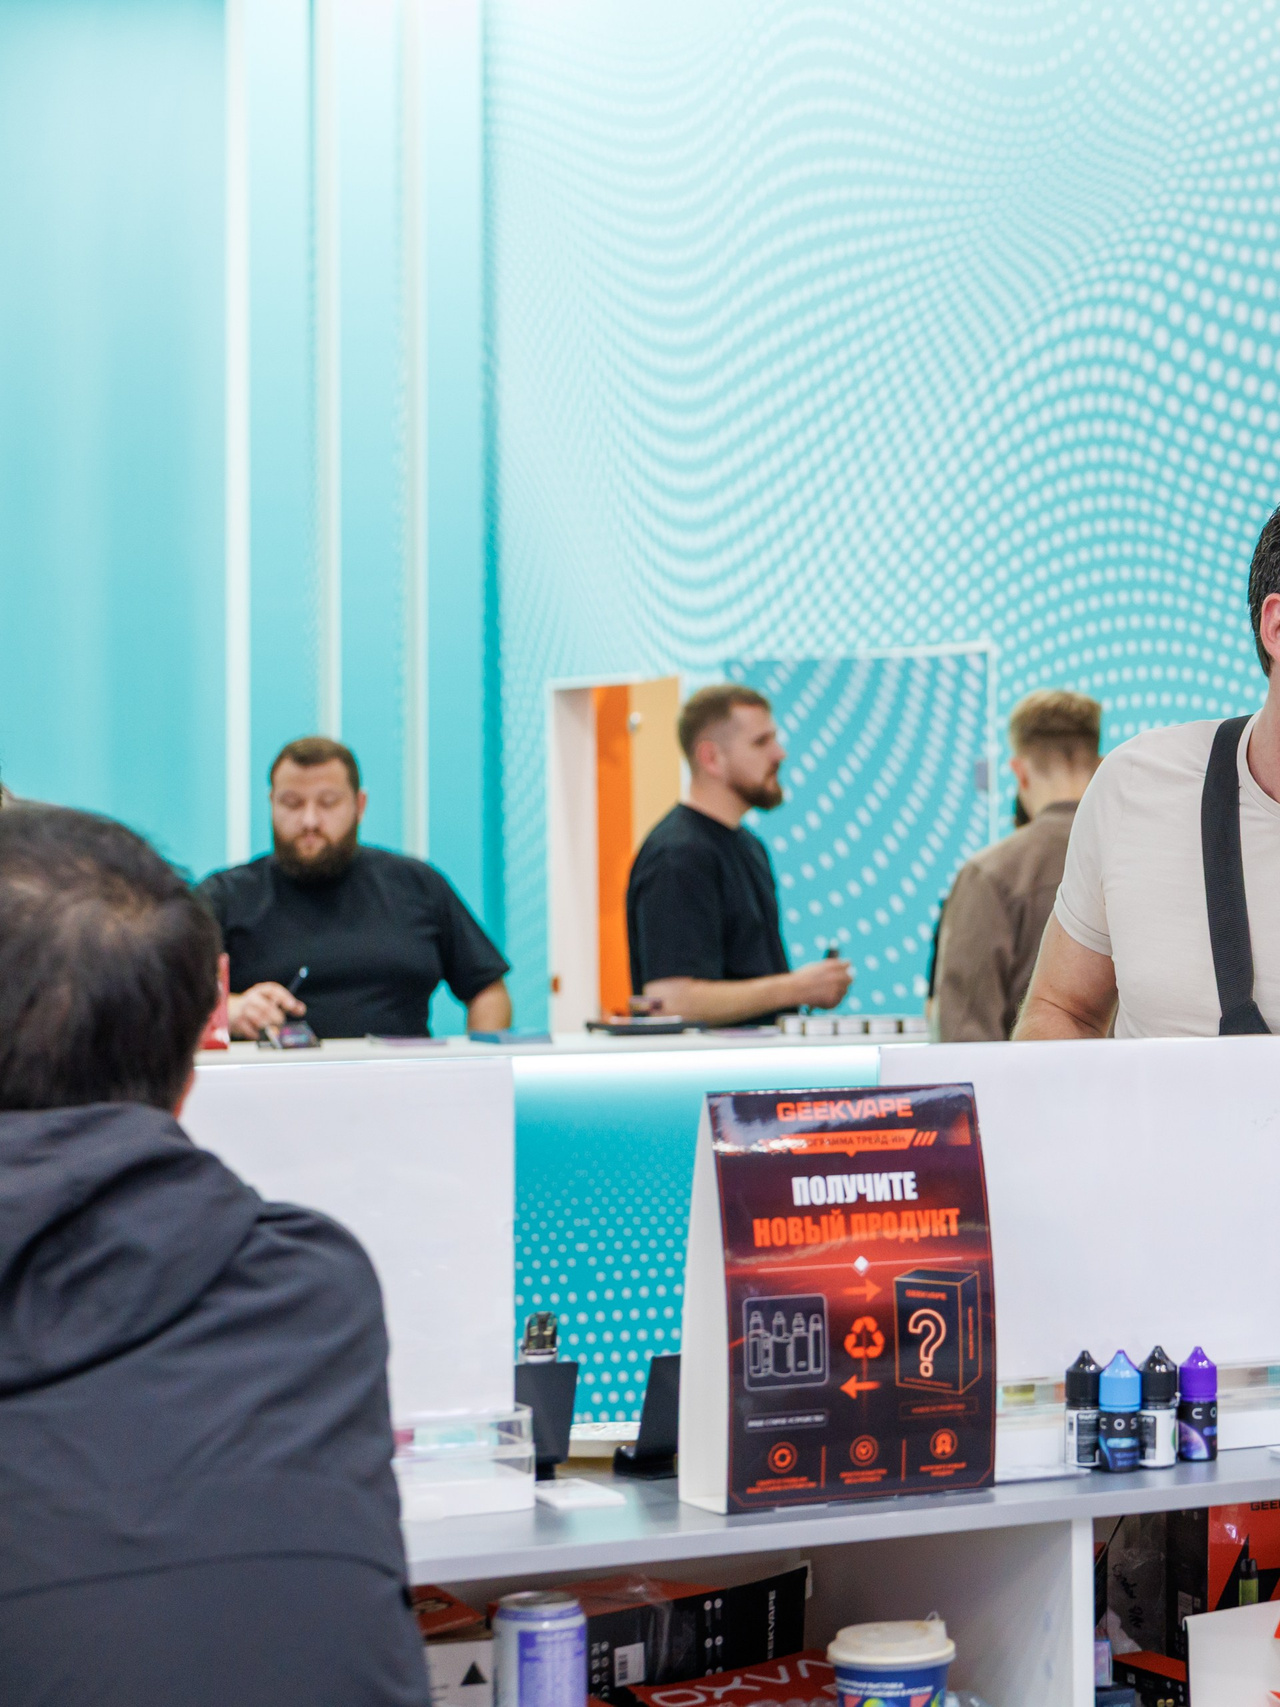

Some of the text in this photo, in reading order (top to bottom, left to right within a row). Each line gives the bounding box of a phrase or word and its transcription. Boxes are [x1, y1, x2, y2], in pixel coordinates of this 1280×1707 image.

[775, 1097, 914, 1122] GEEKVAPE
[806, 1136, 853, 1148] ОГРАММА
[791, 1171, 919, 1206] ПОЛУЧИТЕ
[752, 1208, 960, 1248] НОВЫЙ ПРОДУКТ
